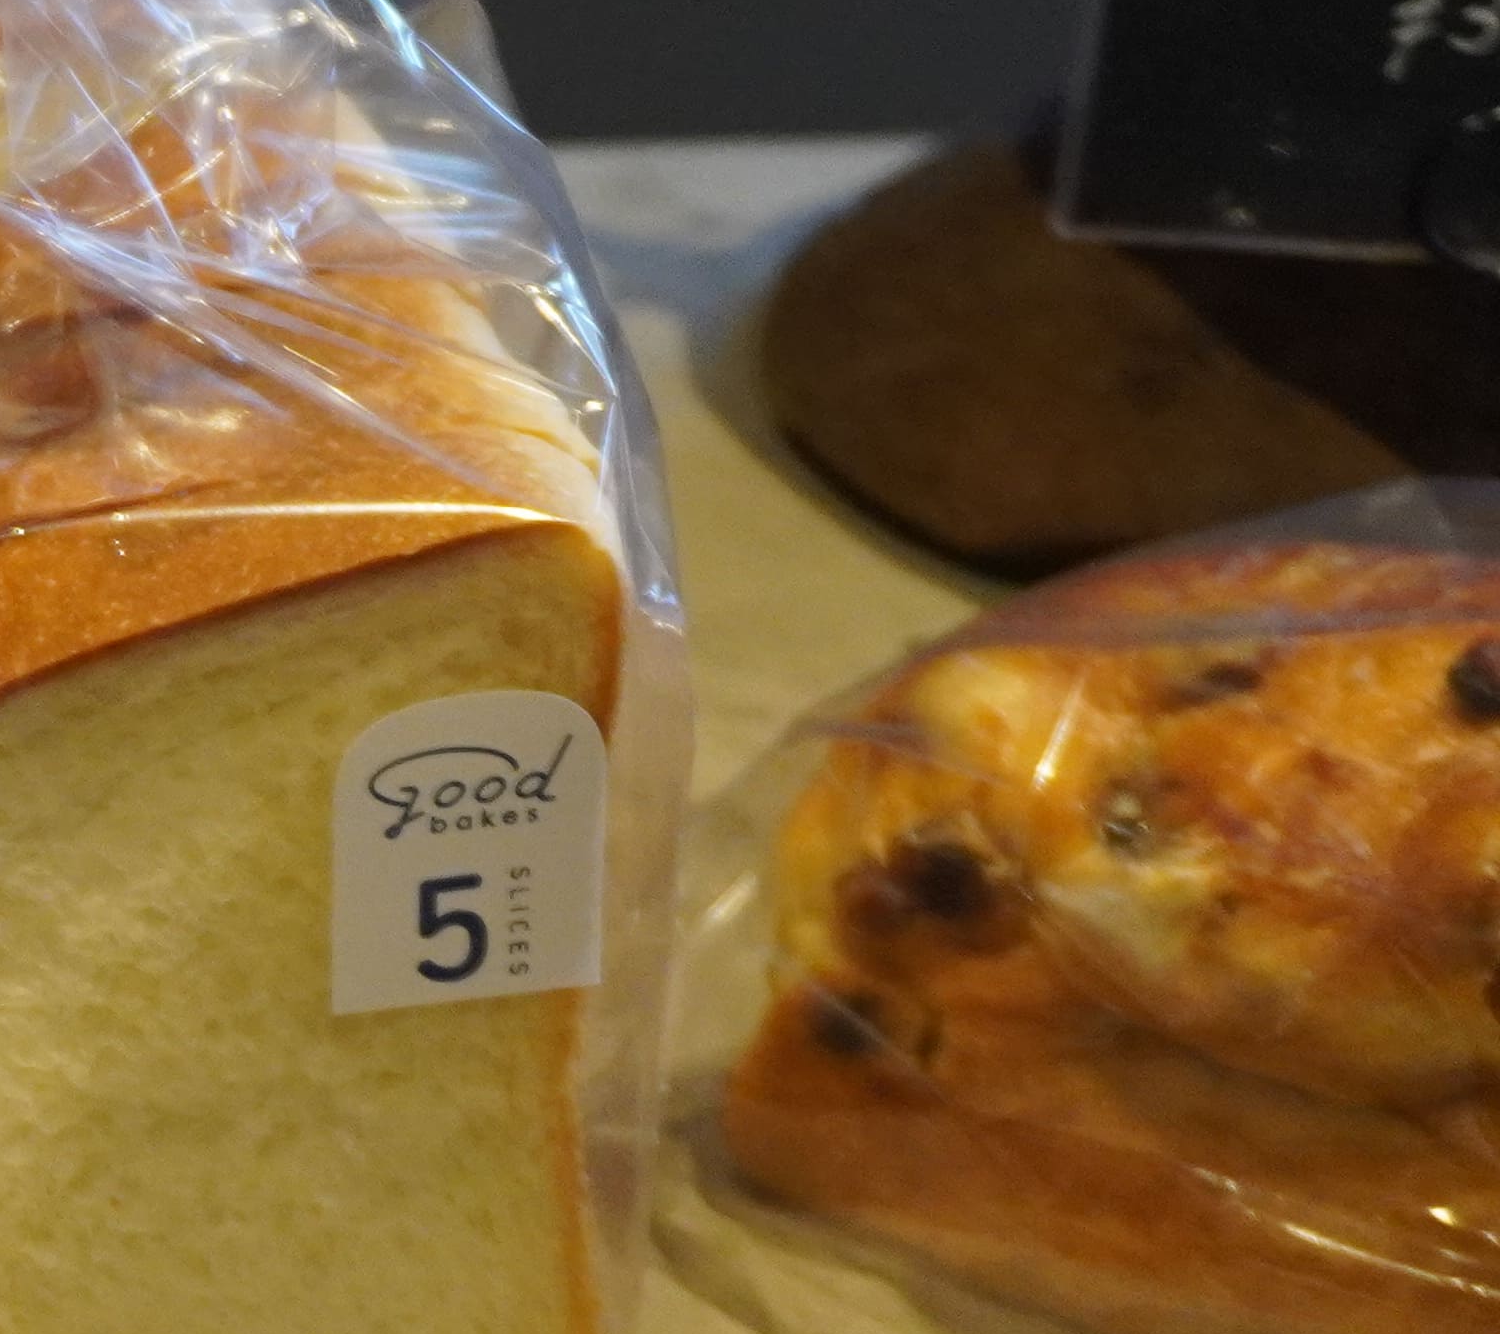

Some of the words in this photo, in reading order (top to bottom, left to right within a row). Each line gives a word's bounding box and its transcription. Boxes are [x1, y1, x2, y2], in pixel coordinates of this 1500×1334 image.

[430, 808, 539, 835] bakes
[417, 873, 489, 983] 5
[508, 866, 531, 976] SLICES
